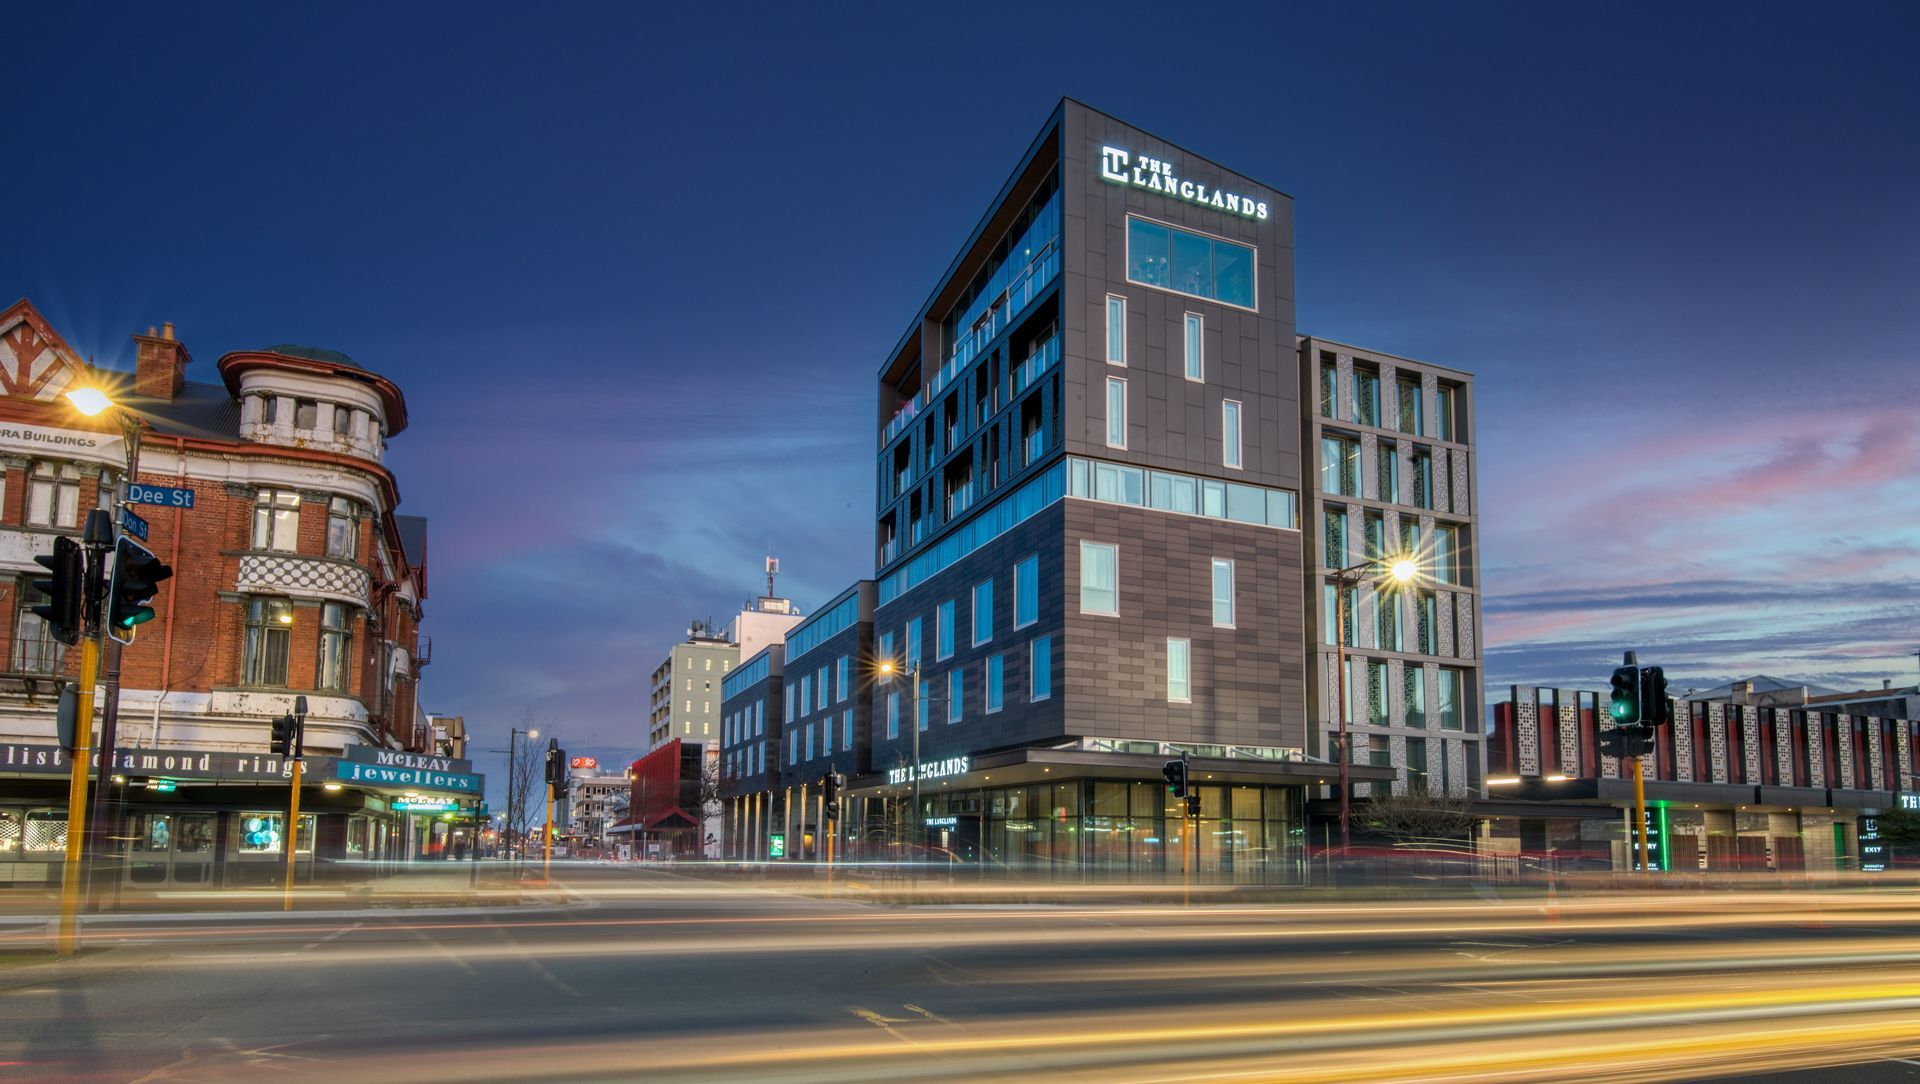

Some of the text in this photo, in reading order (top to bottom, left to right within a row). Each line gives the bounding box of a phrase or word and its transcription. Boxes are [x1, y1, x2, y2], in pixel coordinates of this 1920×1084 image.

[1138, 155, 1172, 177] THE
[1133, 167, 1268, 219] LANGLANDS
[0, 428, 20, 440] RA
[130, 485, 192, 507] Dee St
[124, 511, 148, 539] Don St
[237, 756, 308, 778] rings
[376, 751, 452, 772] McLEAY
[352, 764, 468, 788] jewellers
[889, 768, 906, 784] THE
[1901, 795, 1920, 809] TH
